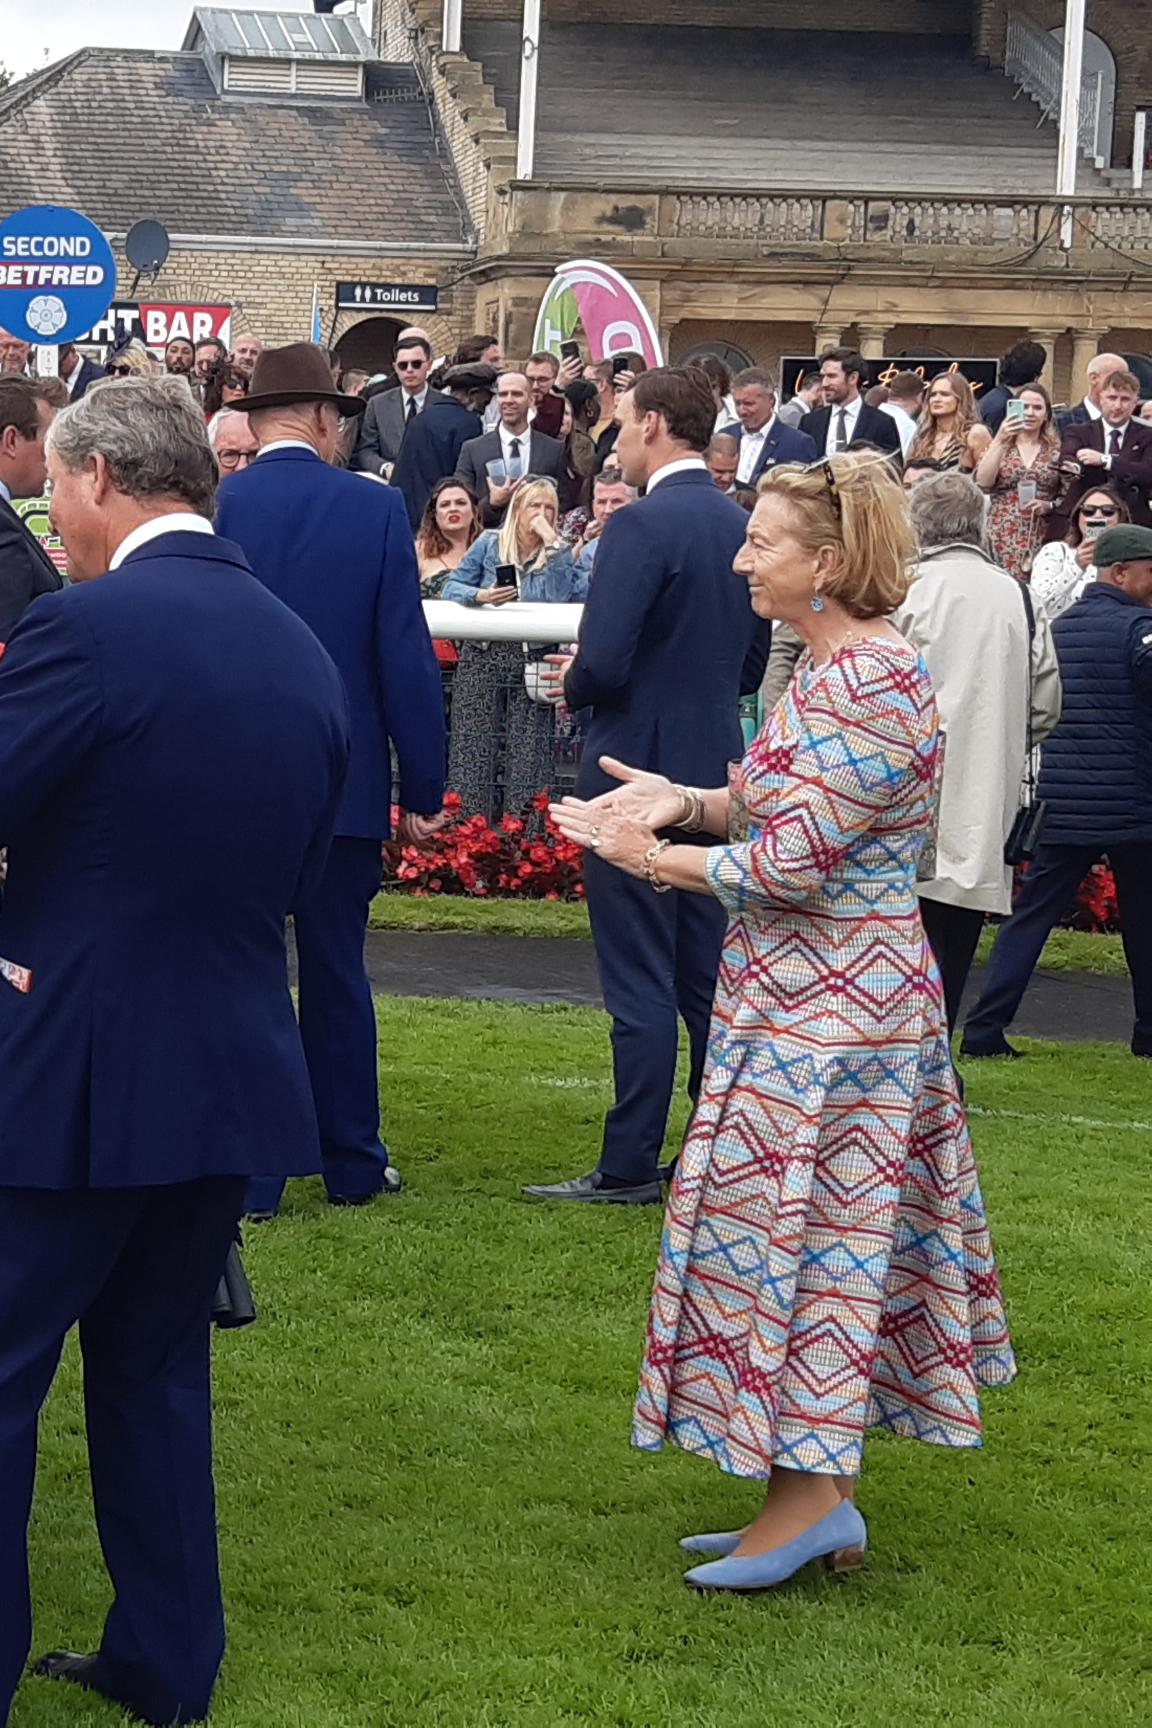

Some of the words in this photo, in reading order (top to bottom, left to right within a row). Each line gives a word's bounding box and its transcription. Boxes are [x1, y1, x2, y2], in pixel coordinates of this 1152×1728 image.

[3, 236, 91, 257] SECOND
[374, 288, 420, 303] Toilets
[146, 310, 213, 344] BAR
